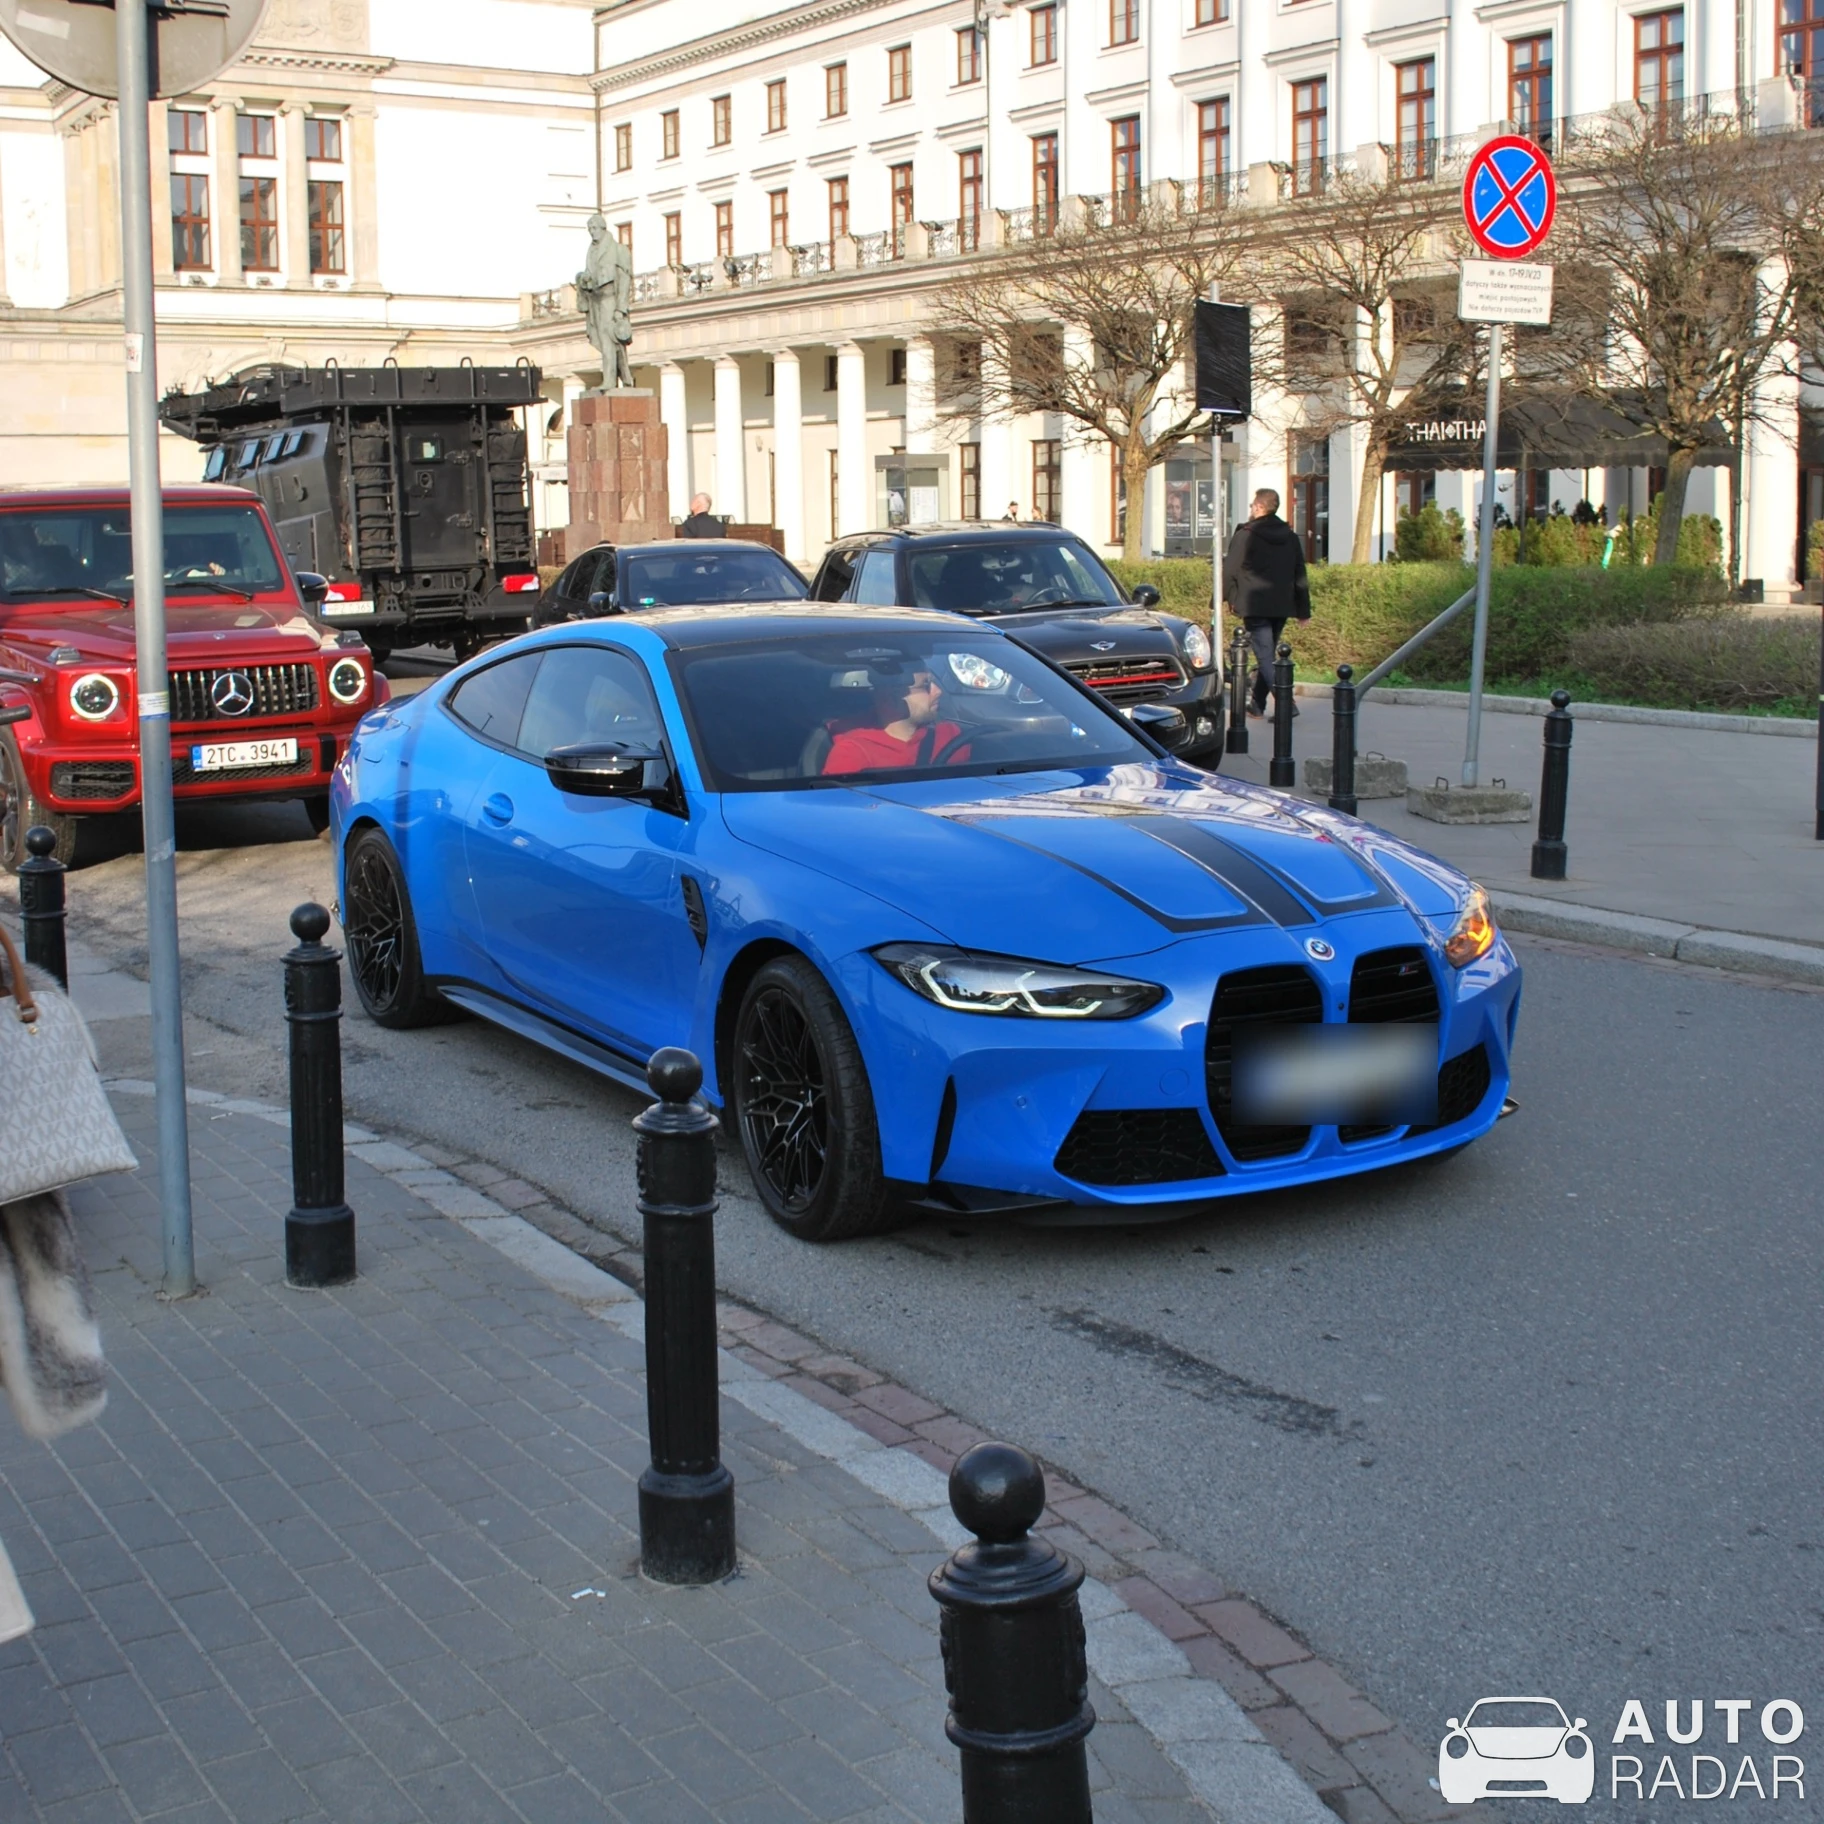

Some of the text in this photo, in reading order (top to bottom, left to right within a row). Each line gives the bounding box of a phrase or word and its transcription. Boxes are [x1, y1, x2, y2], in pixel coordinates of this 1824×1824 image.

[1405, 419, 1487, 441] THAI THA
[249, 742, 289, 761] 3941
